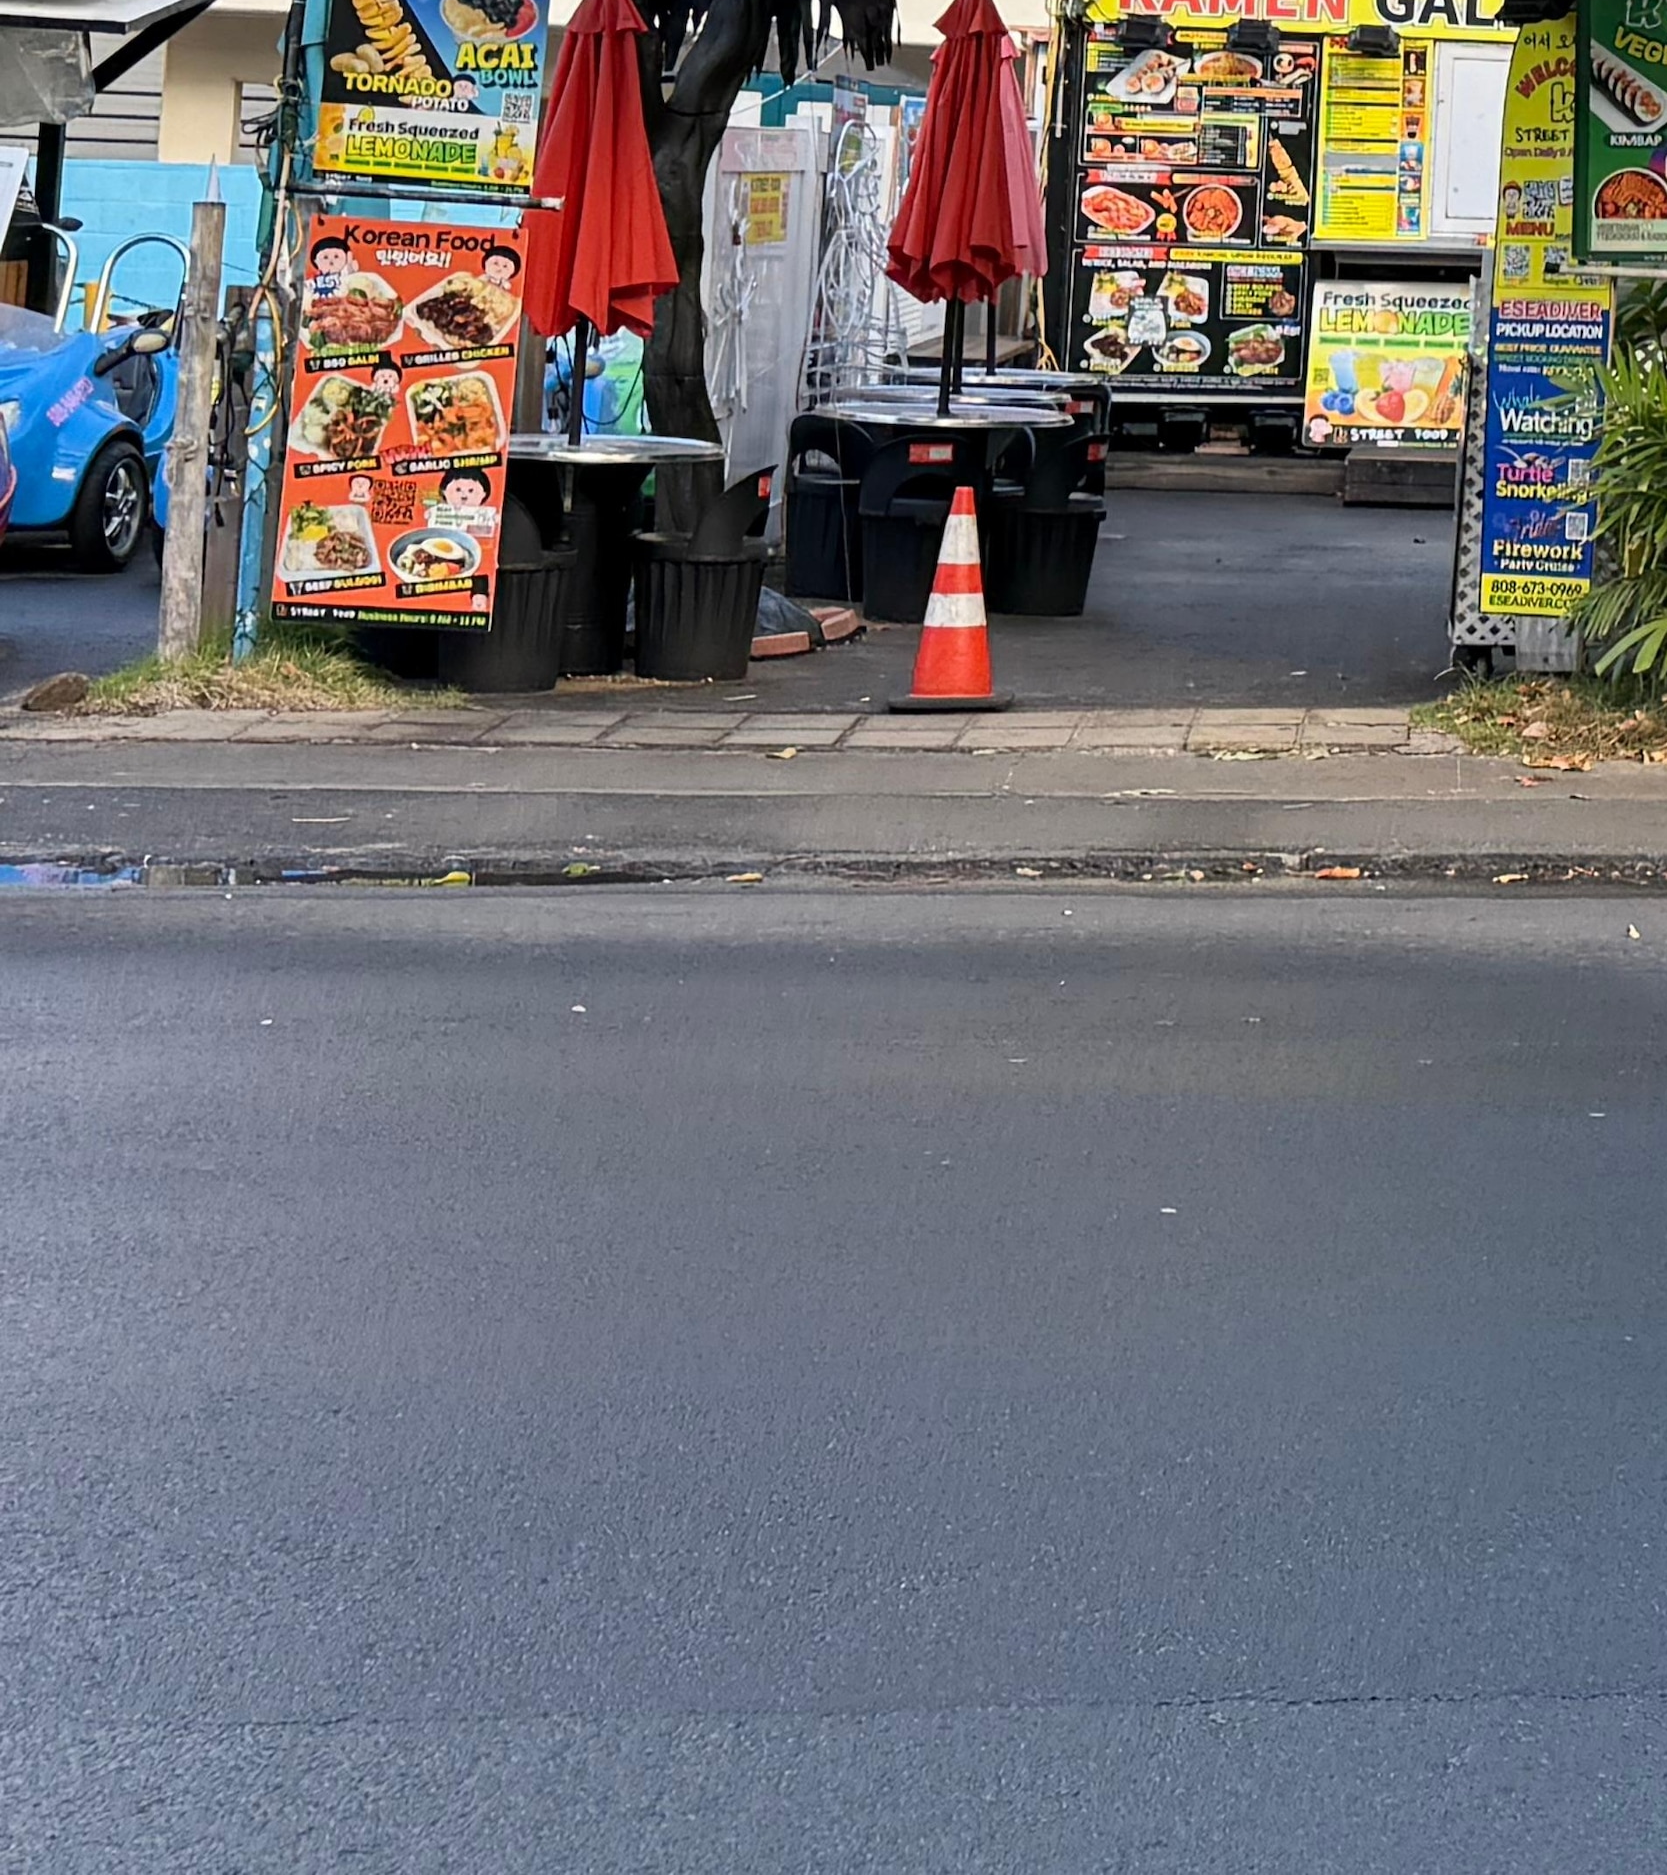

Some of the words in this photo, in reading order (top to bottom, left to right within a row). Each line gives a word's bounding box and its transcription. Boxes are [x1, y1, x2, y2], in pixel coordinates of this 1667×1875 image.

[1523, 31, 1551, 51] 어서
[456, 41, 536, 70] ACAI
[344, 72, 452, 98] TORNADO
[479, 69, 538, 88] BOWL
[411, 95, 469, 112] POTATO
[348, 117, 395, 135] Fresh
[397, 121, 480, 141] Squeezed
[1515, 127, 1570, 142] STREET
[345, 134, 477, 164] LEMONADE
[1610, 134, 1663, 147] KIMBAP
[1506, 221, 1555, 236] MENU
[344, 225, 431, 248] Korean
[435, 230, 495, 252] Food
[1322, 291, 1376, 307] Fresh
[1499, 299, 1602, 321] ESEADIVER
[1318, 307, 1472, 337] LEMONADE
[1496, 322, 1544, 338] PICKUP
[1545, 324, 1603, 340] LOCATION
[414, 352, 460, 365] GRILLED
[460, 346, 510, 359] CHICKEN
[1500, 408, 1594, 442] Watching
[312, 461, 346, 474] SPICY
[347, 458, 377, 471] PORK
[409, 459, 451, 473] GARLIC
[1497, 463, 1554, 483] Turtle
[1493, 539, 1583, 561] Firework
[1500, 558, 1534, 571] Party
[1535, 559, 1575, 573] Cruise
[1491, 580, 1582, 597] 808-673-0969
[1489, 595, 1577, 610] ESEADIVER.CO
